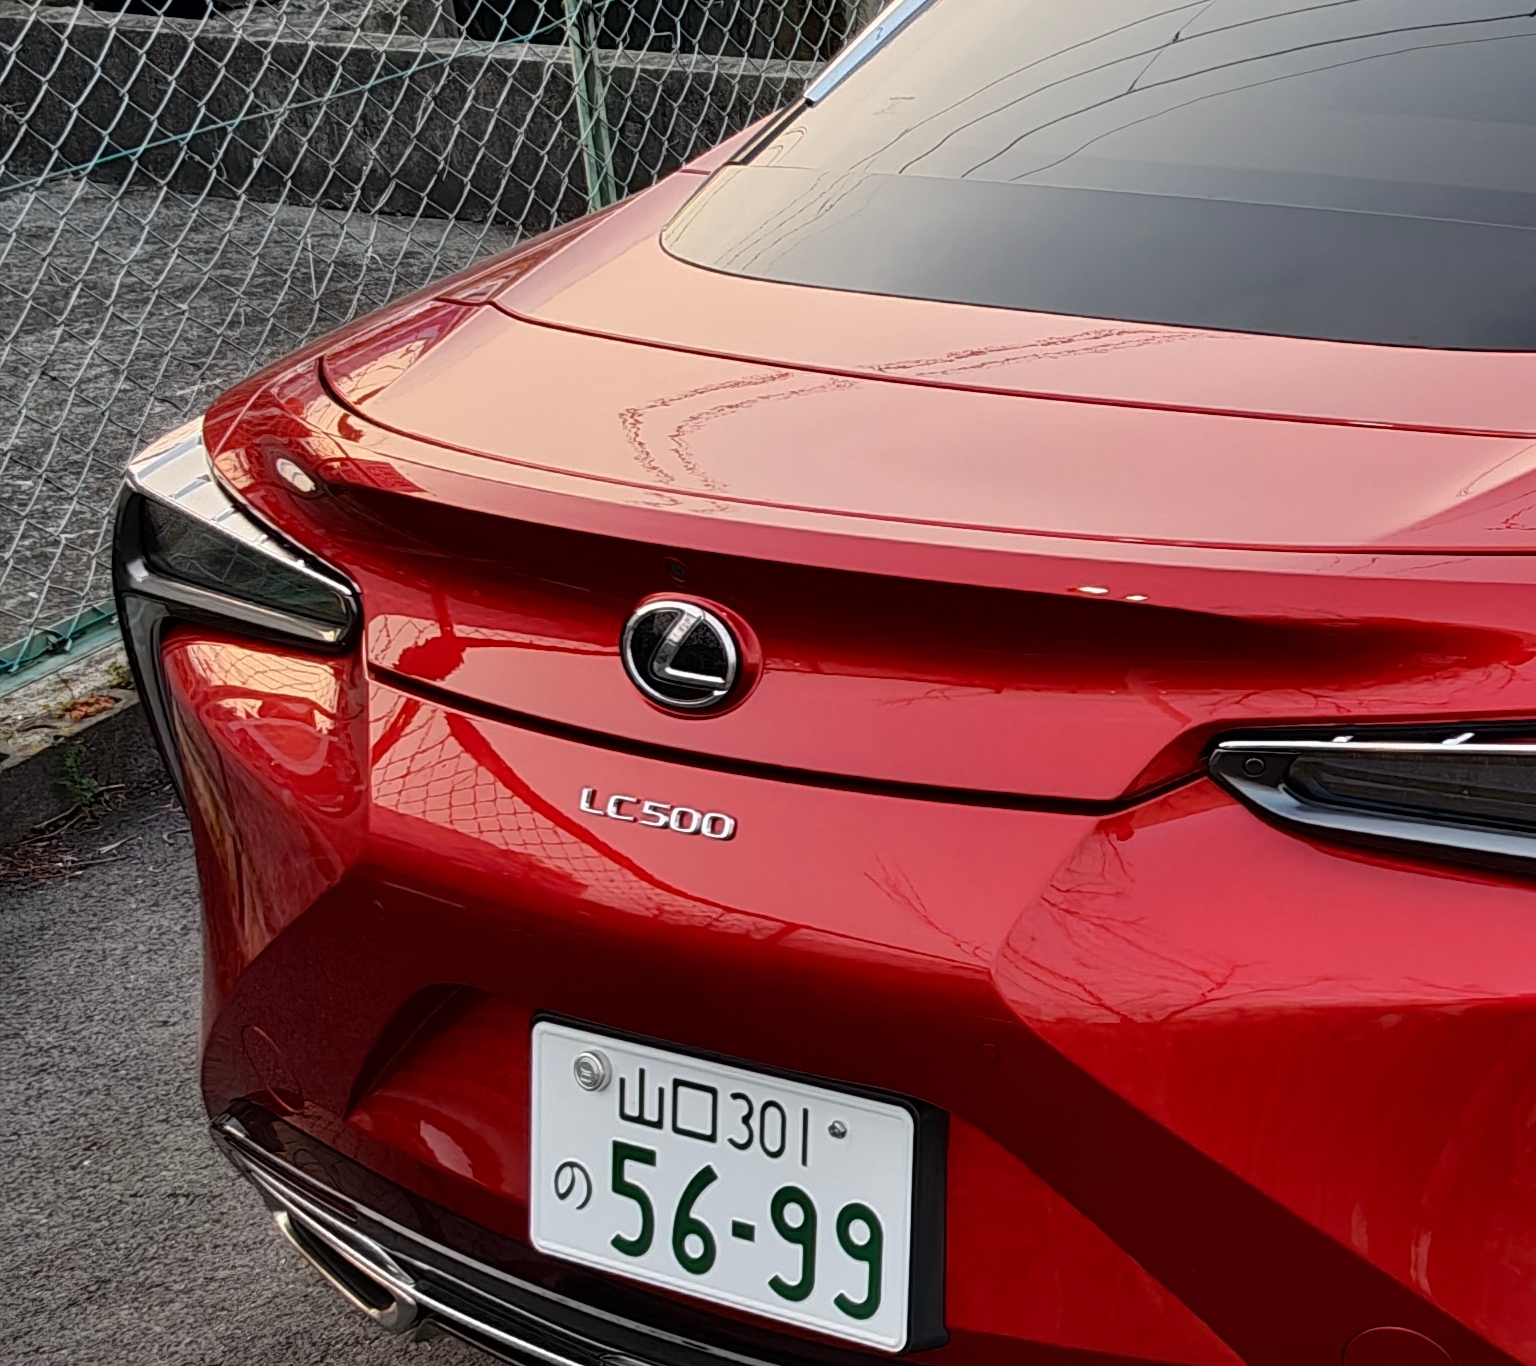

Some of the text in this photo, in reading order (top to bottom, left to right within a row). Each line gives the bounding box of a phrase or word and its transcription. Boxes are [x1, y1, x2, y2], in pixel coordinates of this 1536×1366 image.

[580, 787, 737, 841] LC500
[554, 1139, 884, 1321] の 56-99
